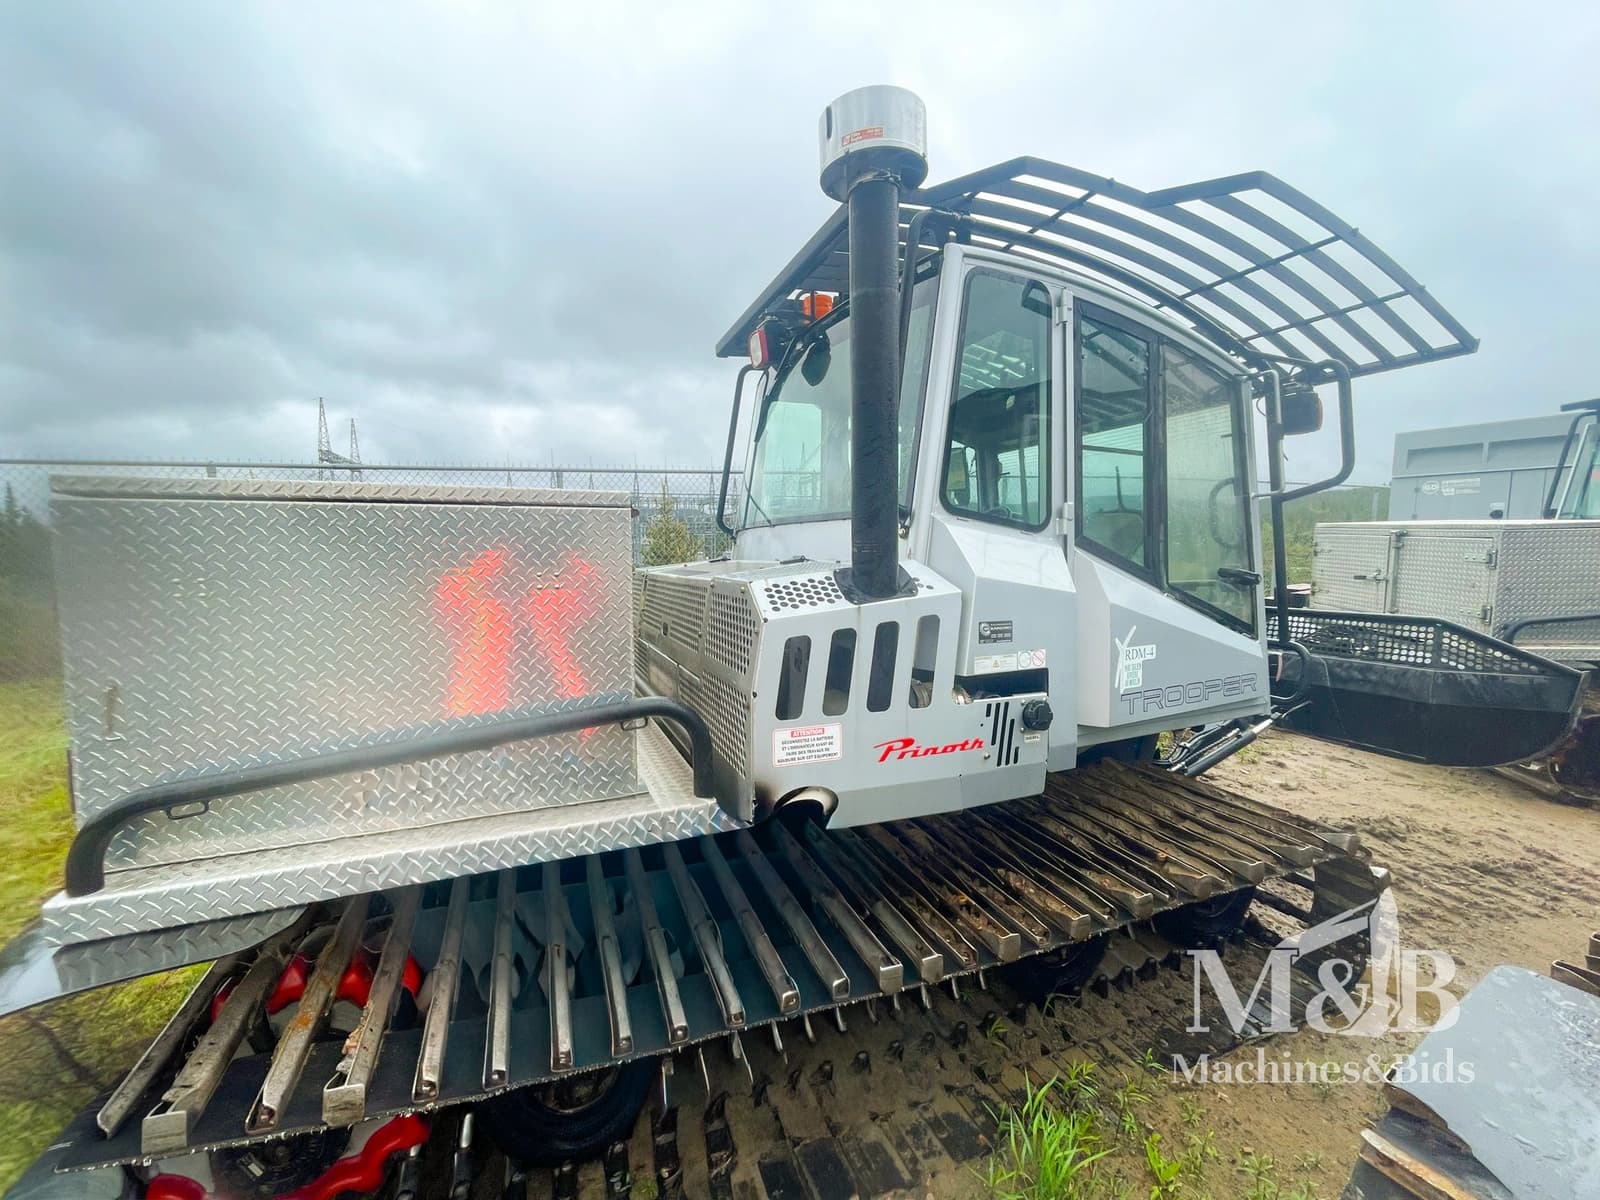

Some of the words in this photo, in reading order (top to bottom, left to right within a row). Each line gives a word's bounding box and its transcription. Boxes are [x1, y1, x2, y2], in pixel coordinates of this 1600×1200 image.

[1125, 646, 1154, 661] RDM-4
[1121, 673, 1257, 715] TROOPER
[792, 728, 823, 737] ATTENTION
[873, 737, 985, 763] Prinoth
